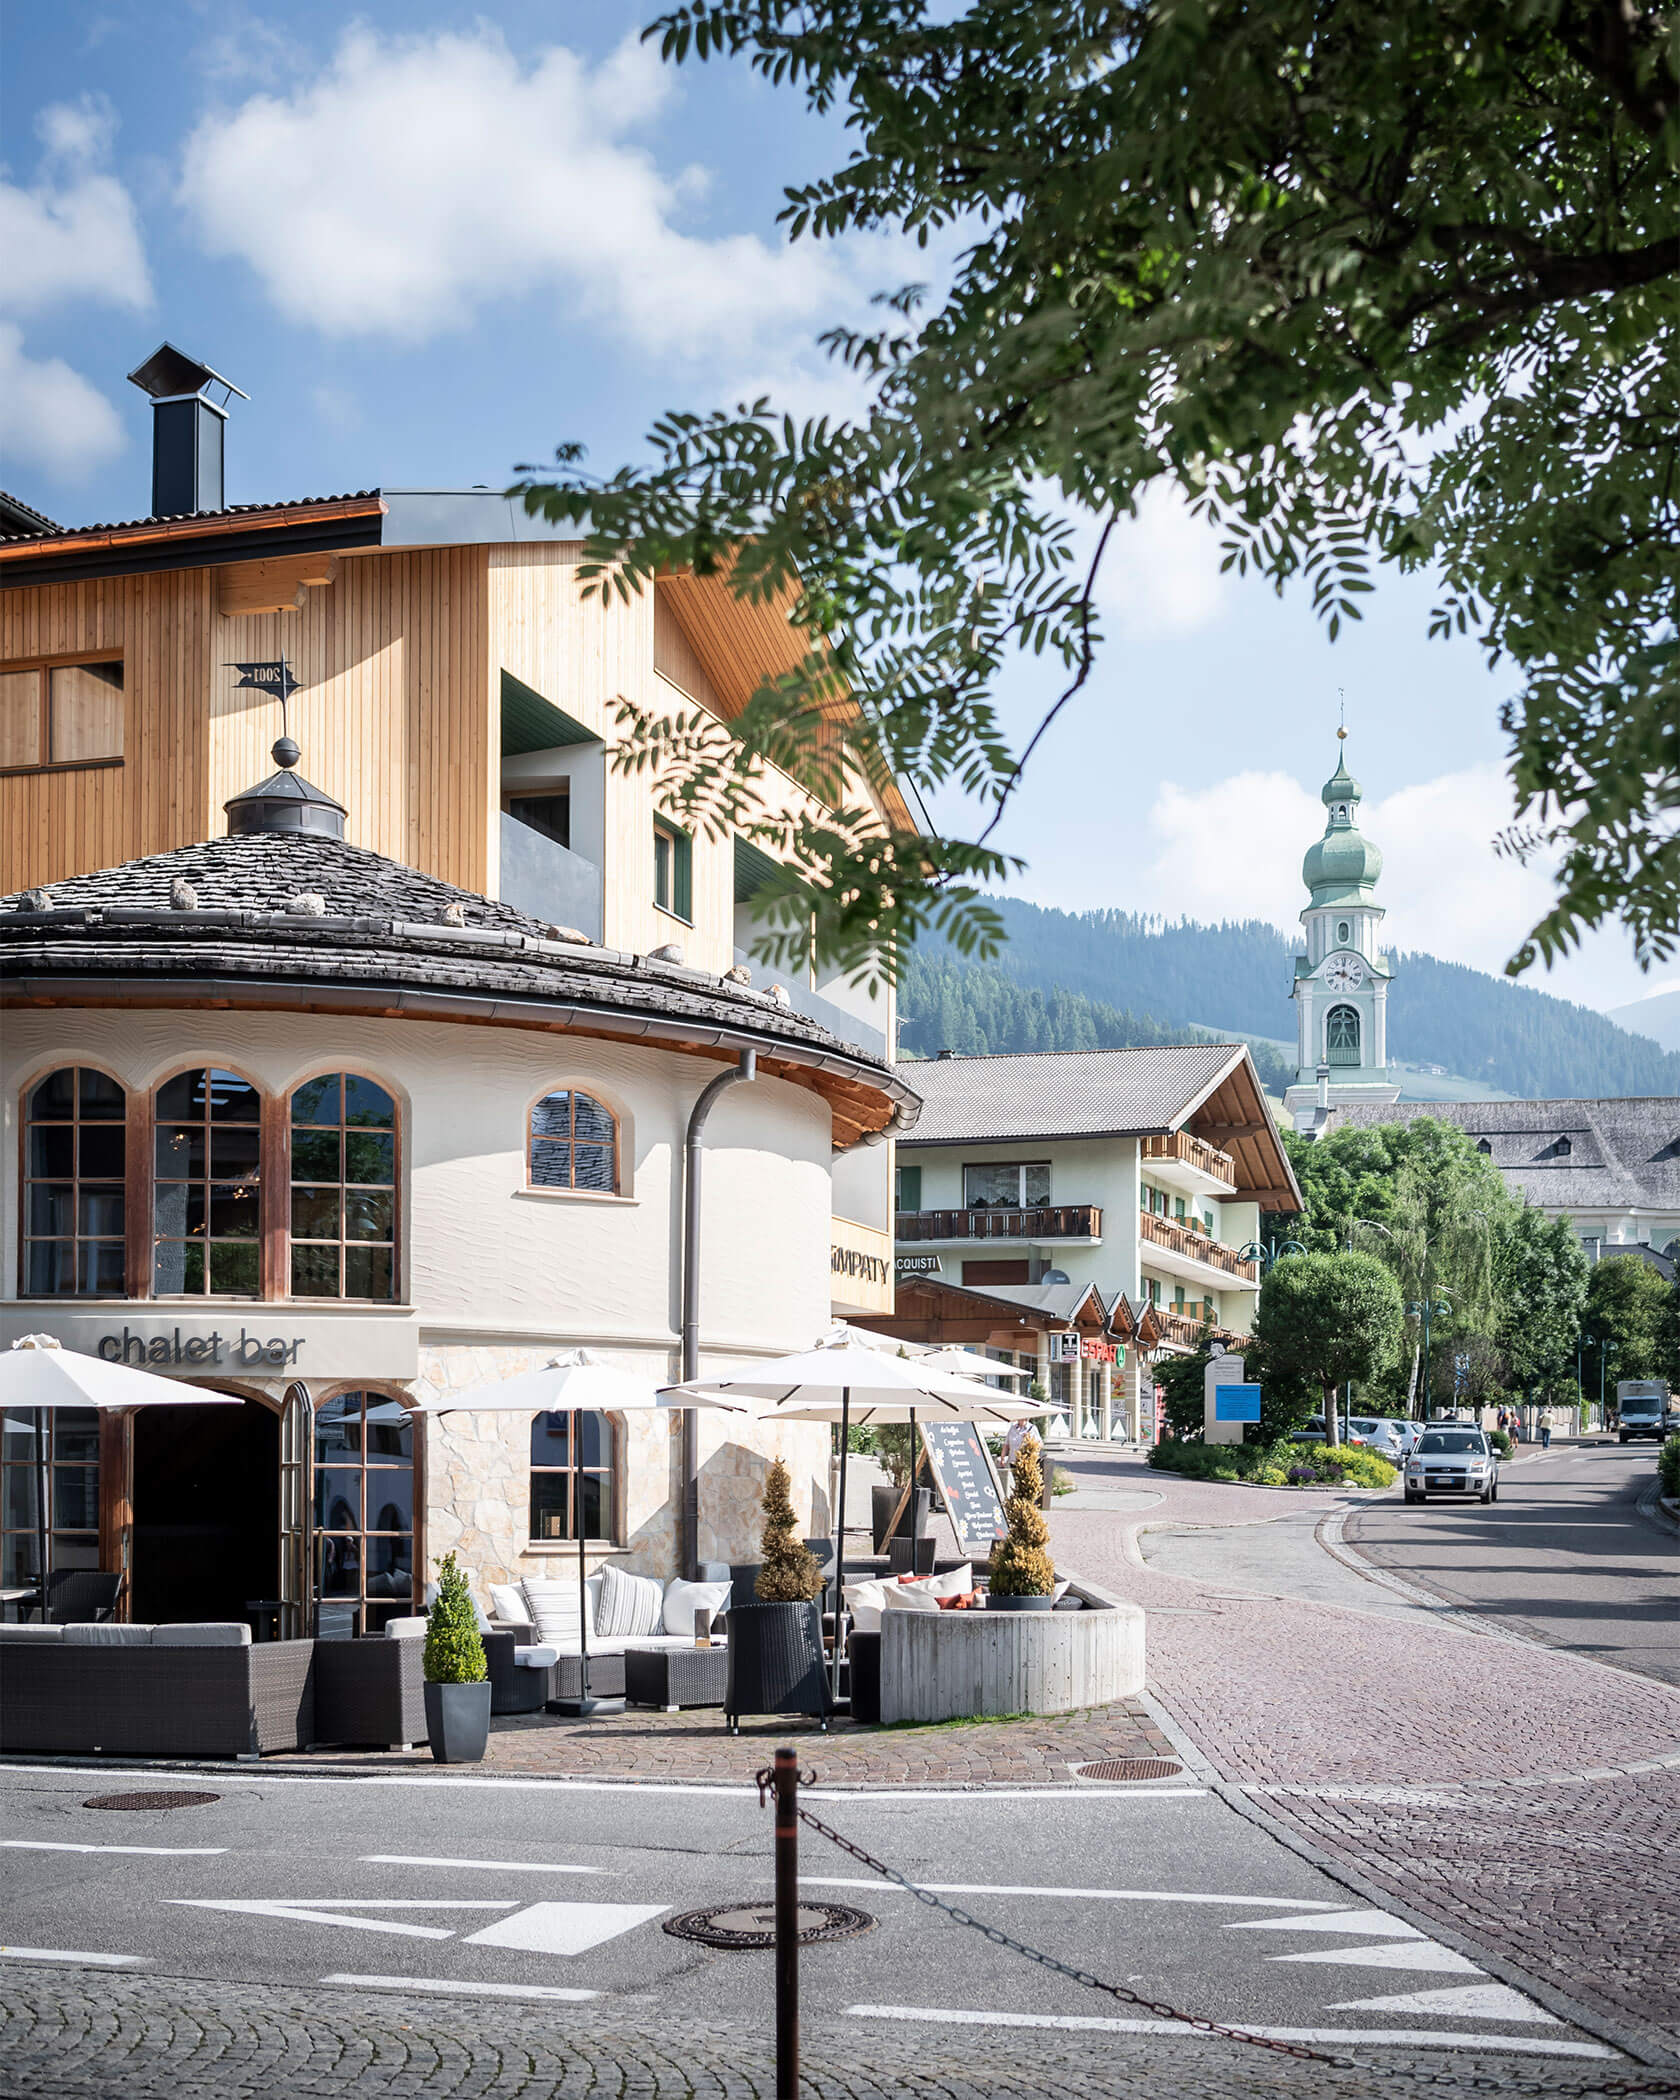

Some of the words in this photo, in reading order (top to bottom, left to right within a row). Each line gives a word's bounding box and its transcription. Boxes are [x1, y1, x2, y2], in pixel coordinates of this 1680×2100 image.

[830, 1244, 890, 1285] IMPATY
[895, 1256, 936, 1270] CQUISTI
[98, 1326, 224, 1364] chalet
[241, 1327, 306, 1365] bar
